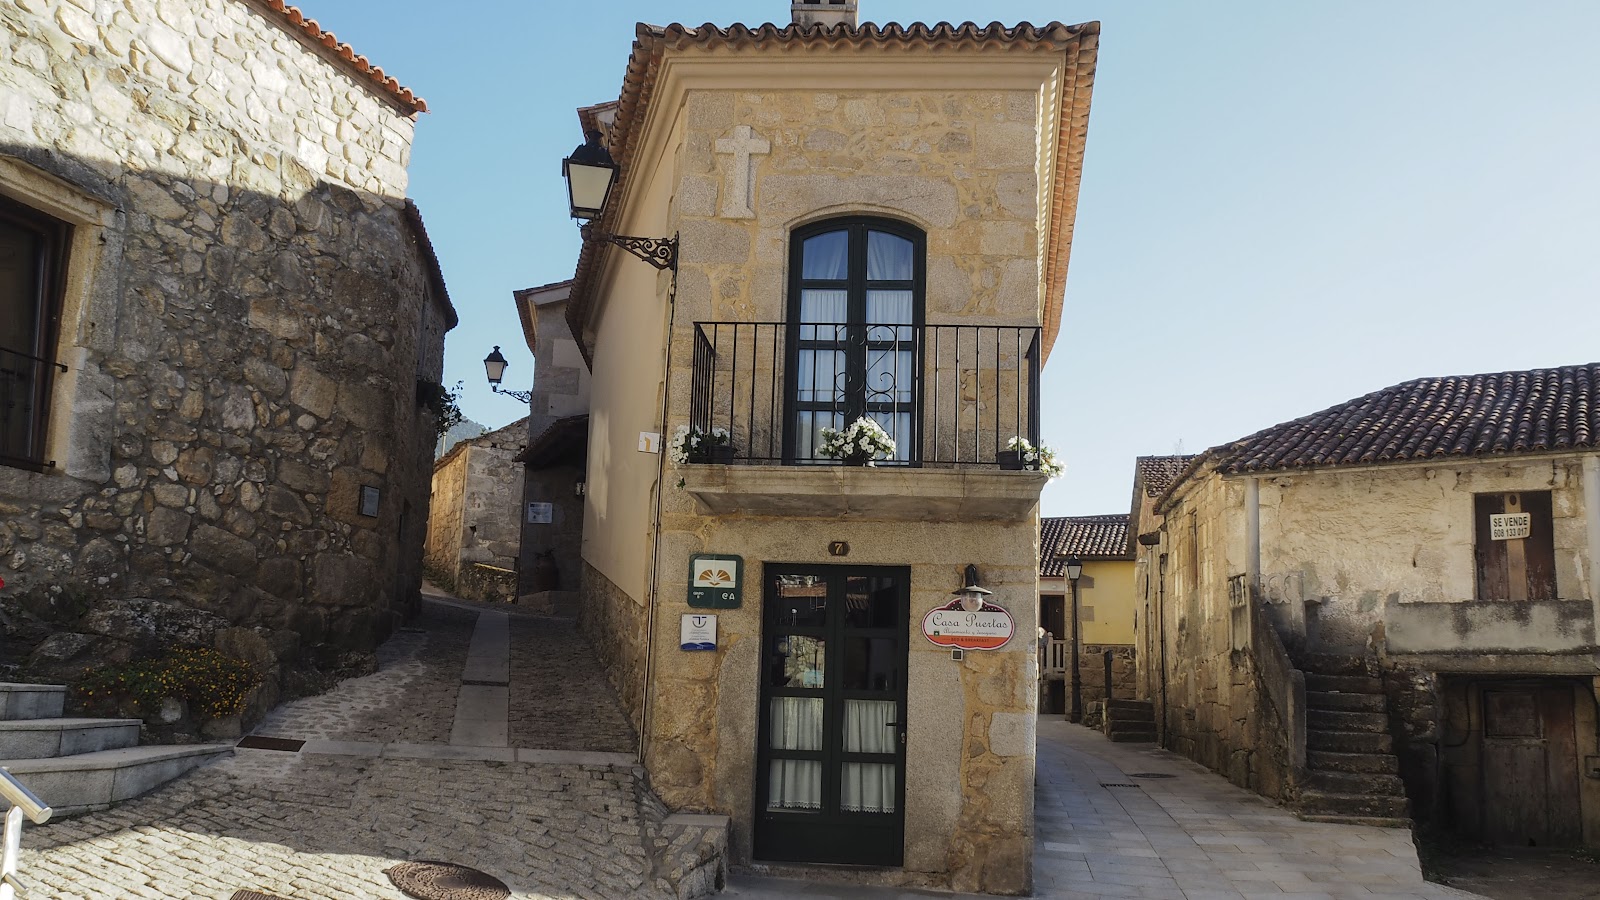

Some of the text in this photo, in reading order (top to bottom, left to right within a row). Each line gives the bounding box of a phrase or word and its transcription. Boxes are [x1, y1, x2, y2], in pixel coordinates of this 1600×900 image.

[1493, 516, 1528, 527] SE VENDE
[1493, 527, 1528, 537] 608 133 017
[834, 543, 843, 555] 7
[932, 612, 1008, 628] Casa Puertas
